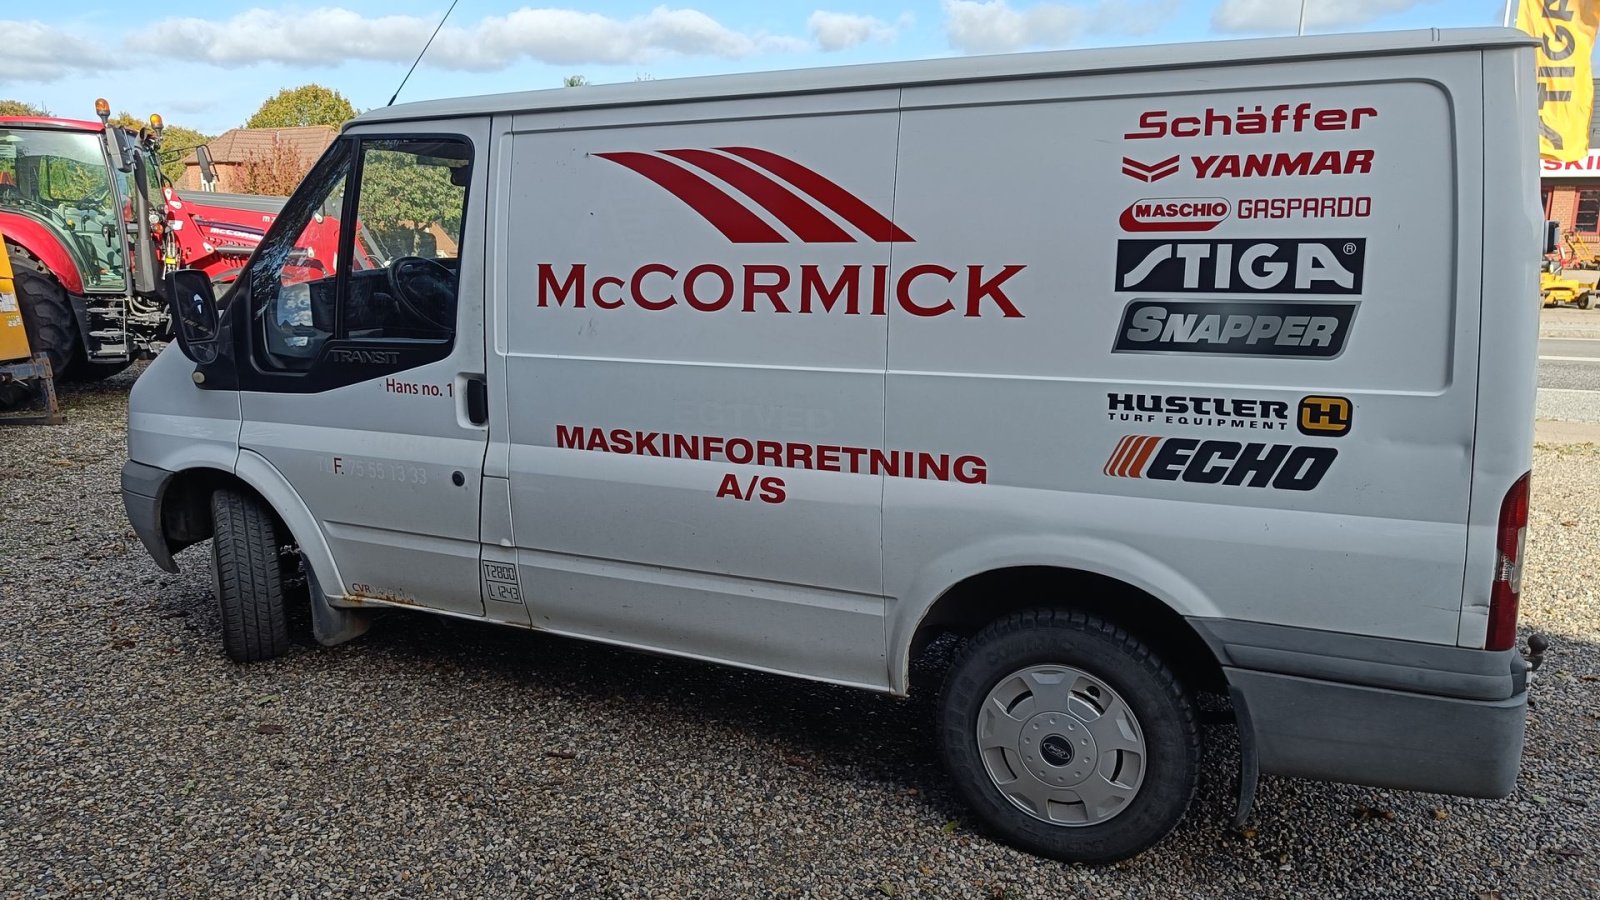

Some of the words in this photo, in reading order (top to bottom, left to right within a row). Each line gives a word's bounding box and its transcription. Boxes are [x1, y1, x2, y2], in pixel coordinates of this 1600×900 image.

[1124, 103, 1378, 139] Schäffer
[1191, 150, 1375, 178] YANMAR
[1135, 203, 1227, 218] MASCHIO
[1238, 197, 1371, 219] GASPARDO
[1123, 243, 1355, 289] STIGA
[536, 263, 1027, 318] McCORMICK
[1126, 306, 1339, 347] SNAPPER
[328, 349, 401, 364] TRANSIT
[386, 377, 418, 394] Hans
[422, 384, 443, 396] no.
[446, 383, 453, 397] 1
[1107, 393, 1288, 419] HUSTLER
[1108, 412, 1155, 423] TURF
[1166, 415, 1288, 431] EQUIPMENT
[556, 424, 988, 484] MASKINFORRETNING
[1146, 437, 1338, 491] ECHO
[716, 473, 786, 504] A/S
[485, 564, 515, 581] T2800
[351, 582, 372, 594] CVR
